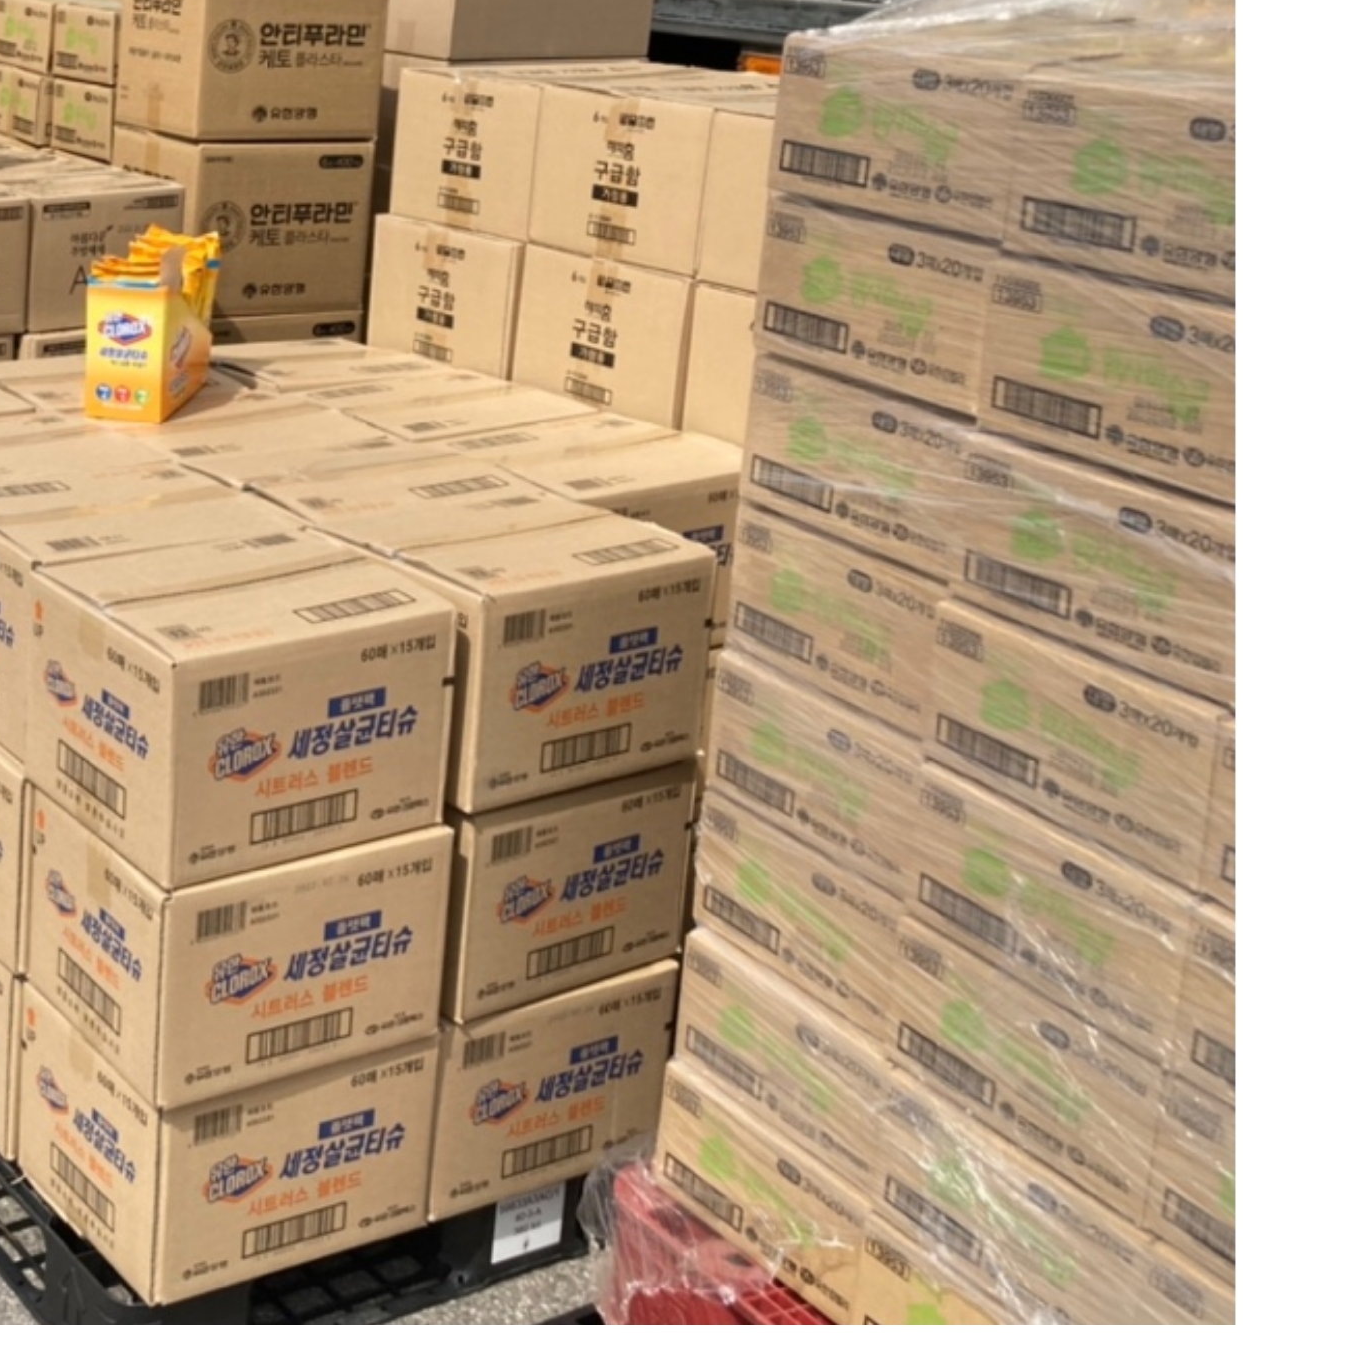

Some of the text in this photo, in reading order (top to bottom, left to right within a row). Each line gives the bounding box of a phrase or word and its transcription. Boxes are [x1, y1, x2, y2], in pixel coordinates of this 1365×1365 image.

[260, 23, 368, 48] 안티푸라민
[250, 201, 354, 225] 안티푸라민
[287, 706, 418, 759] 세정살균티슈
[283, 926, 413, 980] 세정살균티슈
